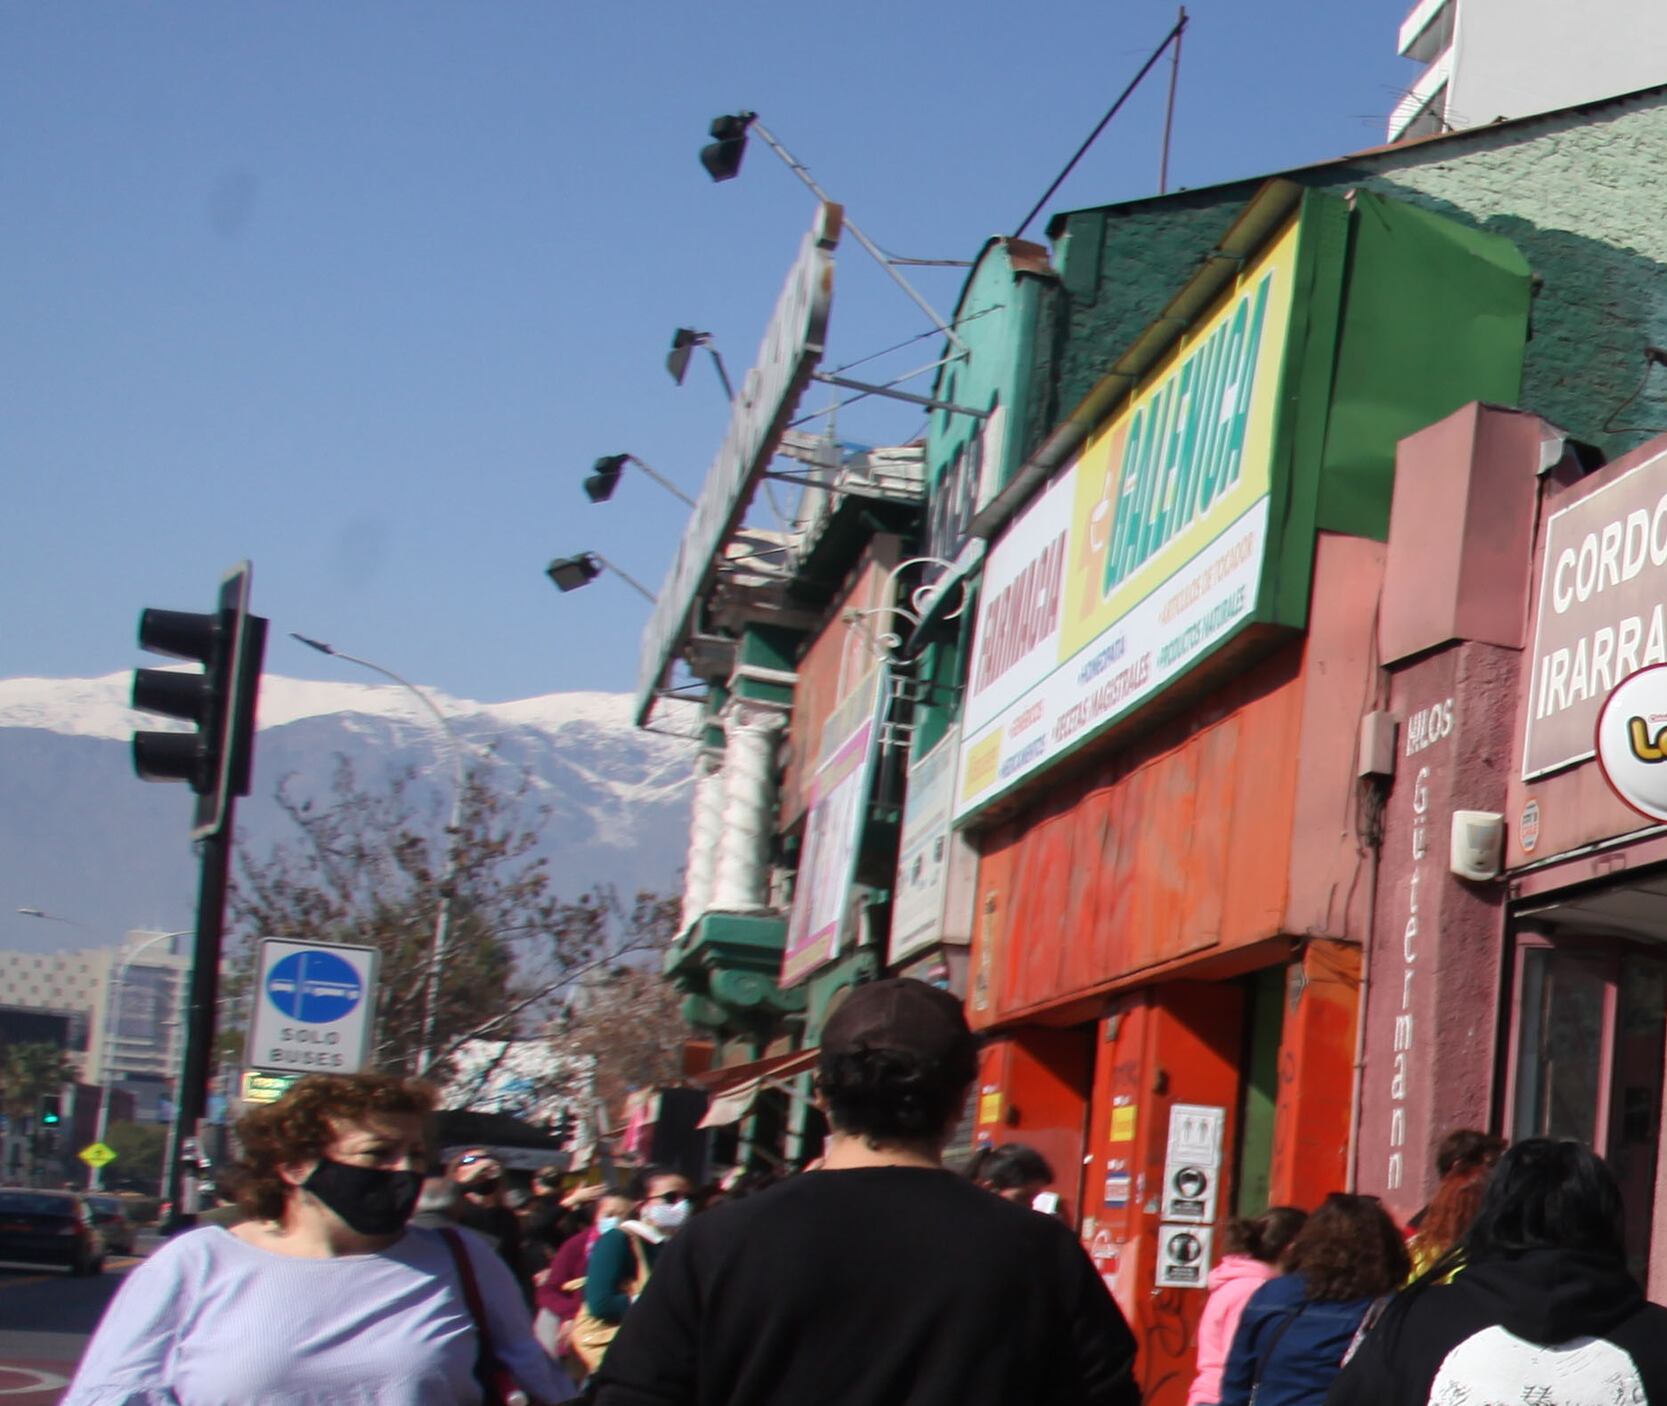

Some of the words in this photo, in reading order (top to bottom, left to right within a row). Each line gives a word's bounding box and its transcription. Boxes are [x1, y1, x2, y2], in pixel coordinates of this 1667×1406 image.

[972, 527, 1069, 698] FARMACIA
[1406, 698, 1454, 757] HILOS
[281, 1027, 340, 1045] SOLO
[269, 1048, 344, 1067] BUSES
